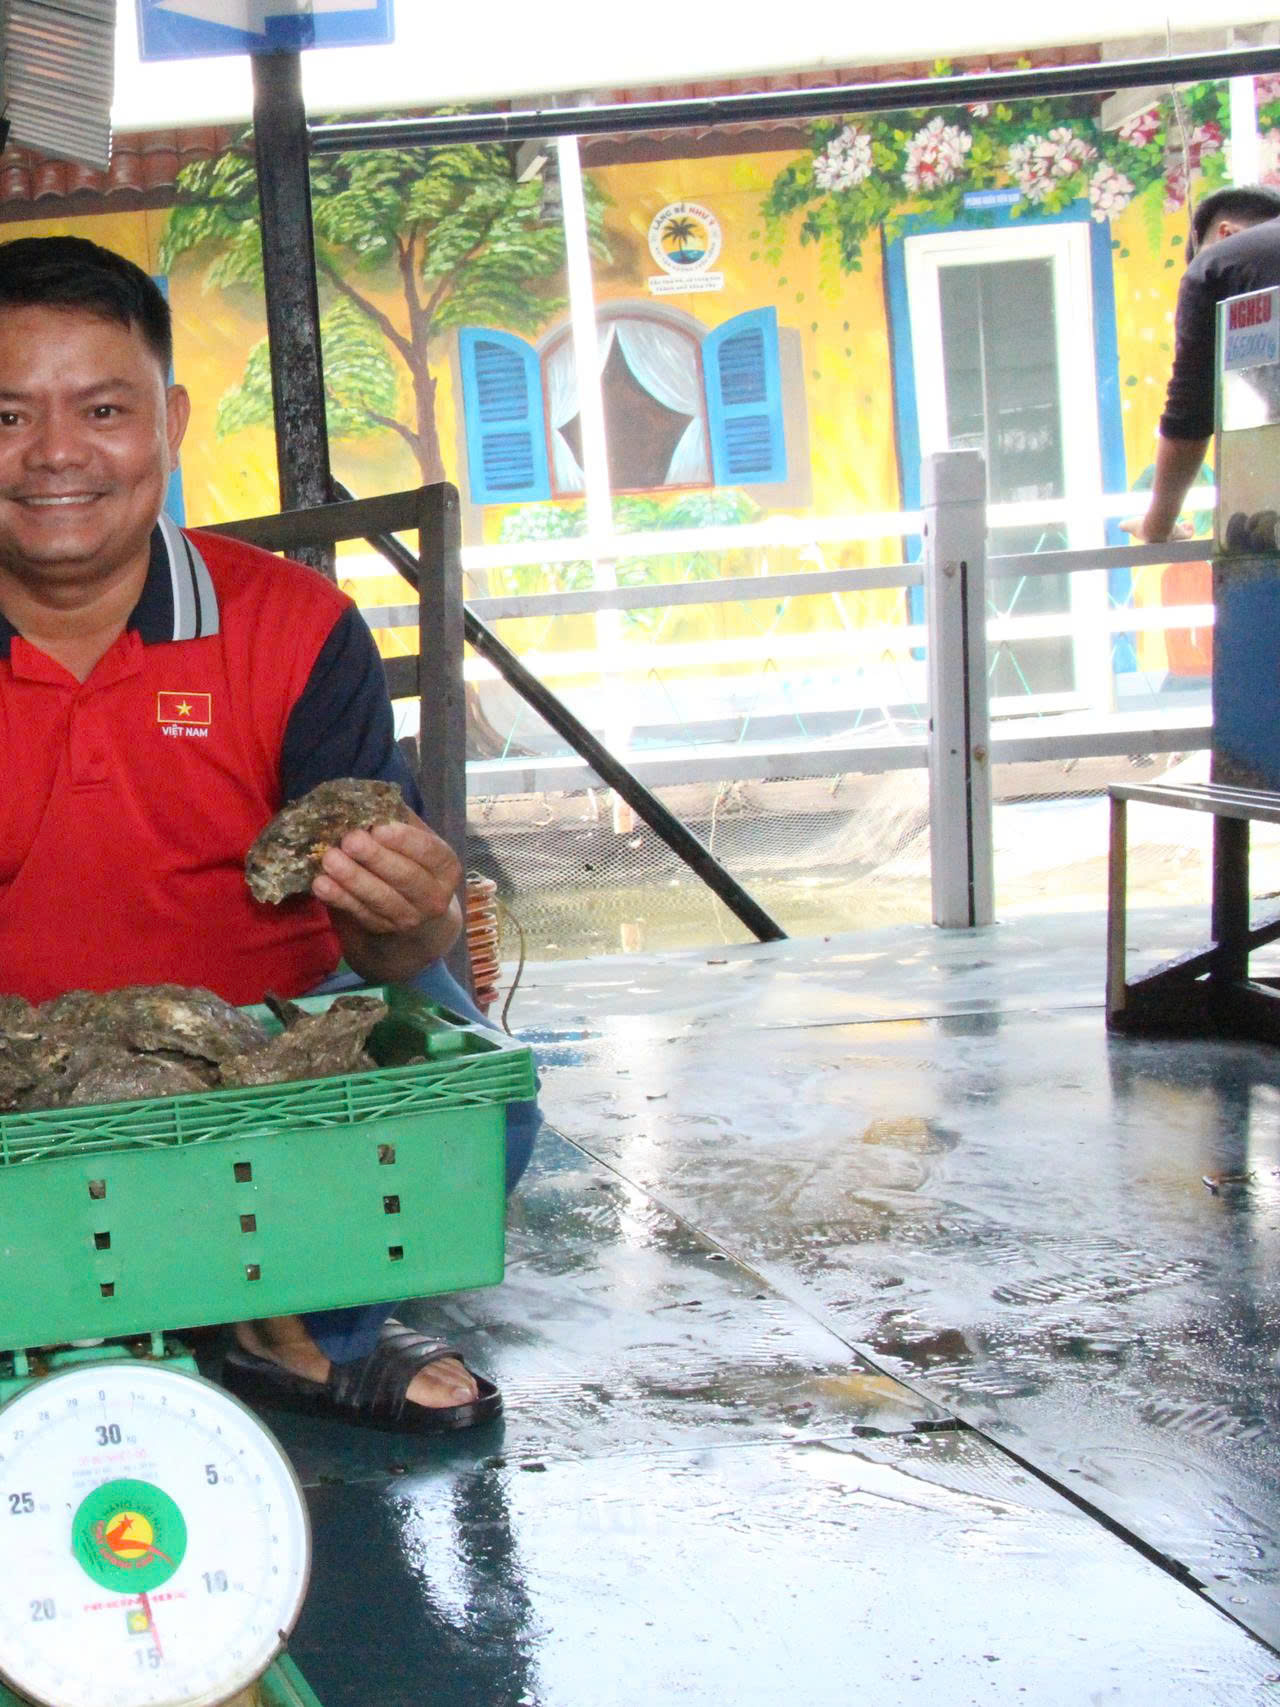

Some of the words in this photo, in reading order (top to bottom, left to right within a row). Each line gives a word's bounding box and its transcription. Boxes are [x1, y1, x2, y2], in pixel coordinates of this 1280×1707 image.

[162, 724, 184, 738] VIỆT
[185, 727, 208, 738] NAM
[161, 1396, 167, 1406] 2
[190, 1408, 196, 1418] 3
[95, 1423, 122, 1447] 30
[205, 1464, 219, 1485] 5
[8, 1491, 35, 1515] 25
[202, 1570, 228, 1594] 10
[29, 1598, 56, 1622] 20
[135, 1649, 161, 1669] 15
